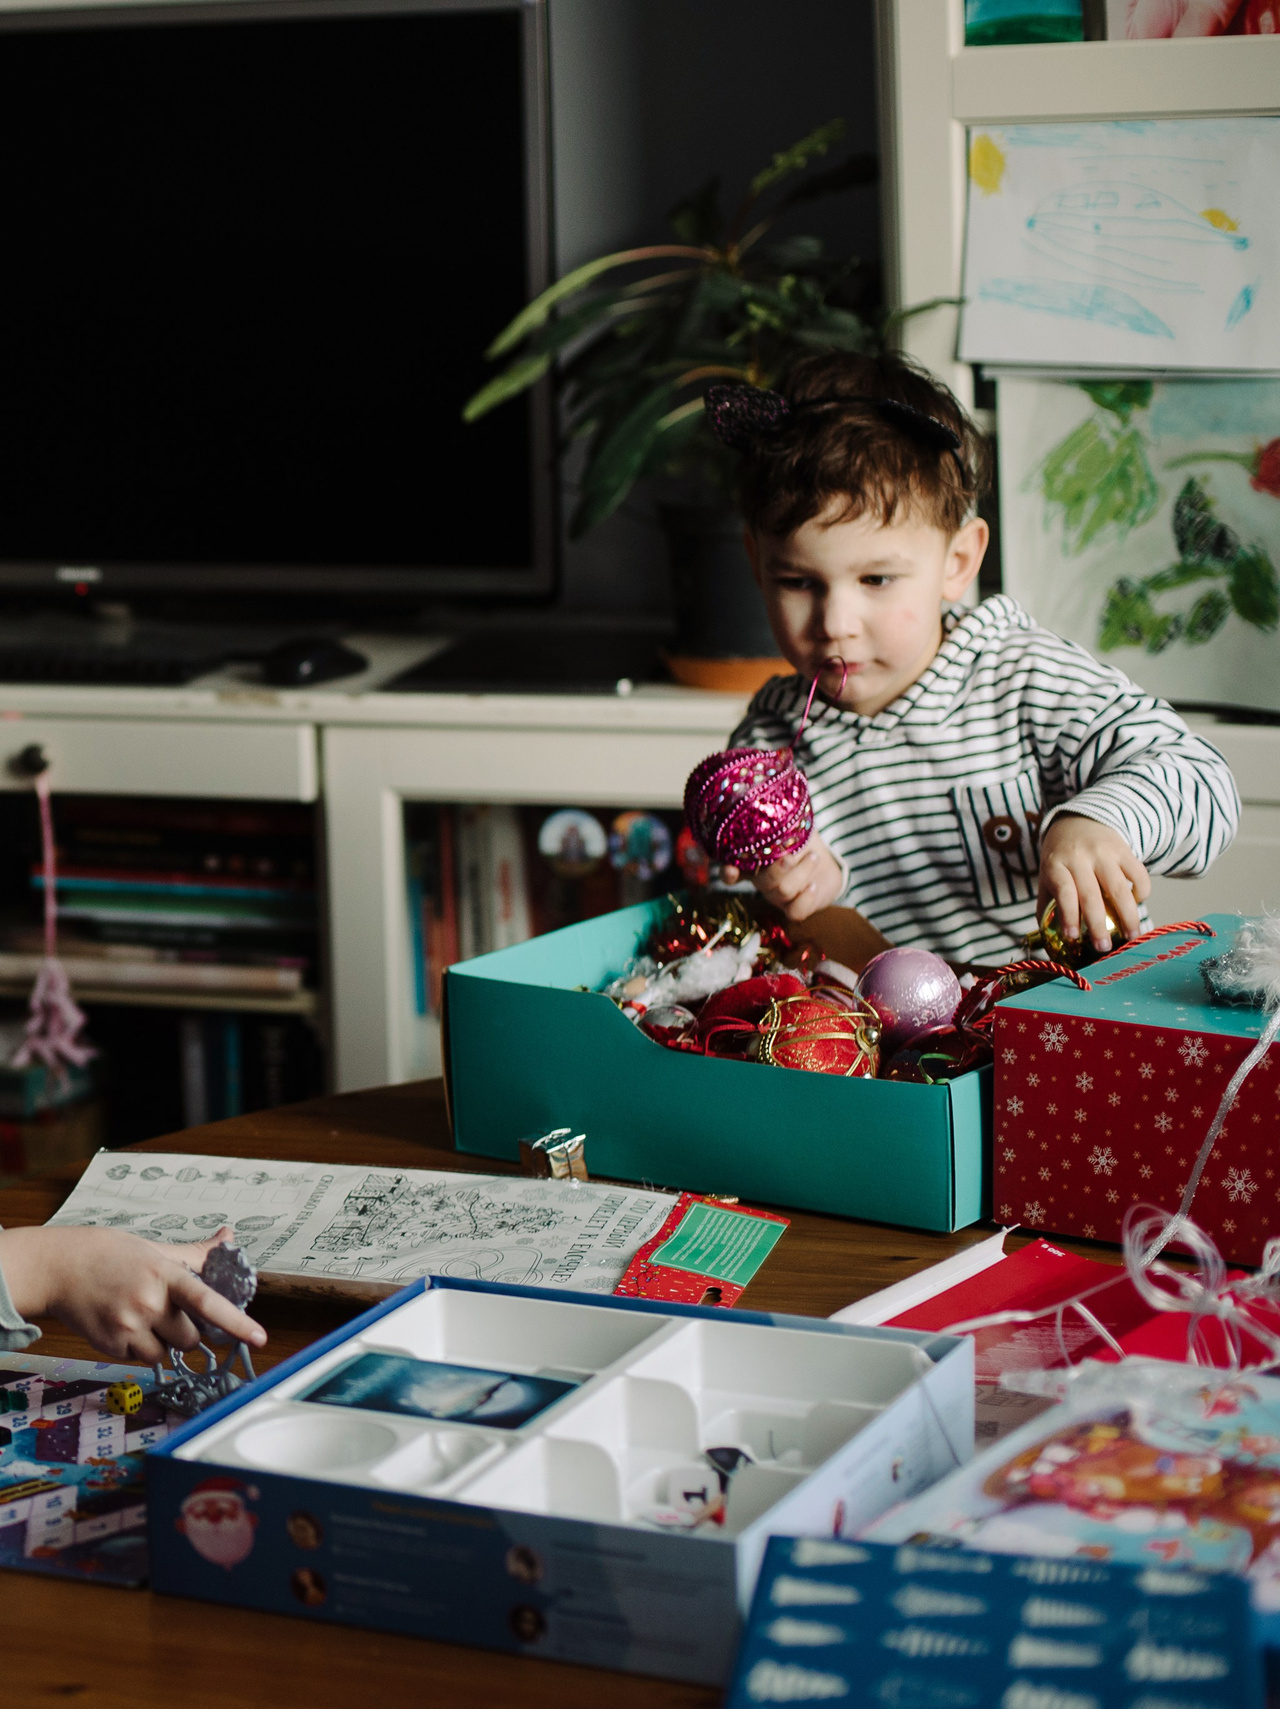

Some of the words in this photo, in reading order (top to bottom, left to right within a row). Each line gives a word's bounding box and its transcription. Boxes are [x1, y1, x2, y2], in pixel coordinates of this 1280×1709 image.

[304, 1174, 334, 1210] СКОЛЬКО
[584, 1192, 628, 1230] ПРИЕДЕТ
[630, 1197, 657, 1214] КТО
[296, 1210, 313, 1221] НА
[601, 1214, 644, 1249] ПЕРВЫЙ
[549, 1243, 595, 1284] ЁЛОЧКЕ?
[56, 1402, 72, 1415] 29
[12, 1415, 28, 1428] 28
[97, 1426, 113, 1439] 32
[139, 1431, 156, 1446] 34
[96, 1444, 113, 1457] 33
[682, 1486, 707, 1505] 1
